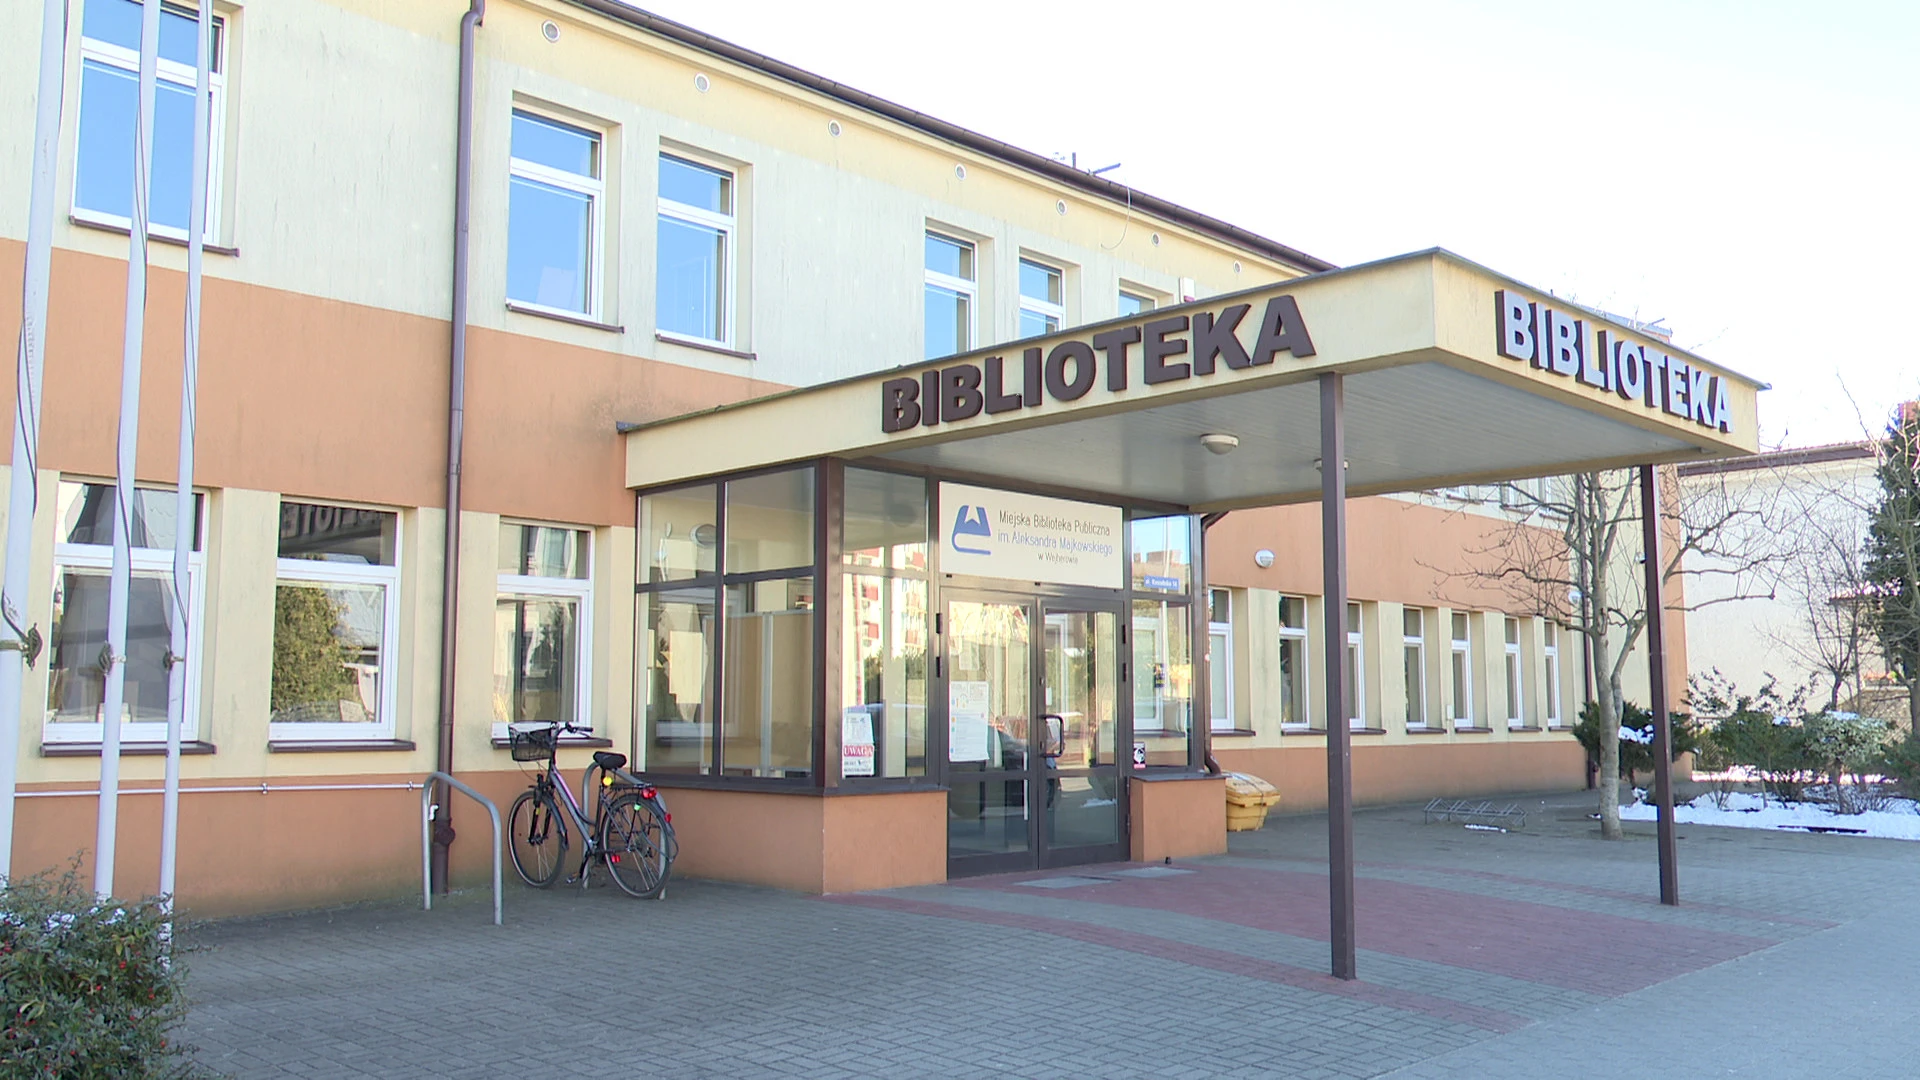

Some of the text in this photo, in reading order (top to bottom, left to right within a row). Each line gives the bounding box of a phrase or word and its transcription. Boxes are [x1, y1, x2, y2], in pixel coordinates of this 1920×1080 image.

[881, 294, 1317, 433] BIBLIOTEKA
[1494, 289, 1733, 433] BIBLIOTEKA
[999, 509, 1111, 537] Miejska Biblioteka Publiczna
[997, 529, 1113, 557] im. Aleksandra Majkowskiego
[844, 745, 874, 757] UWAGA
